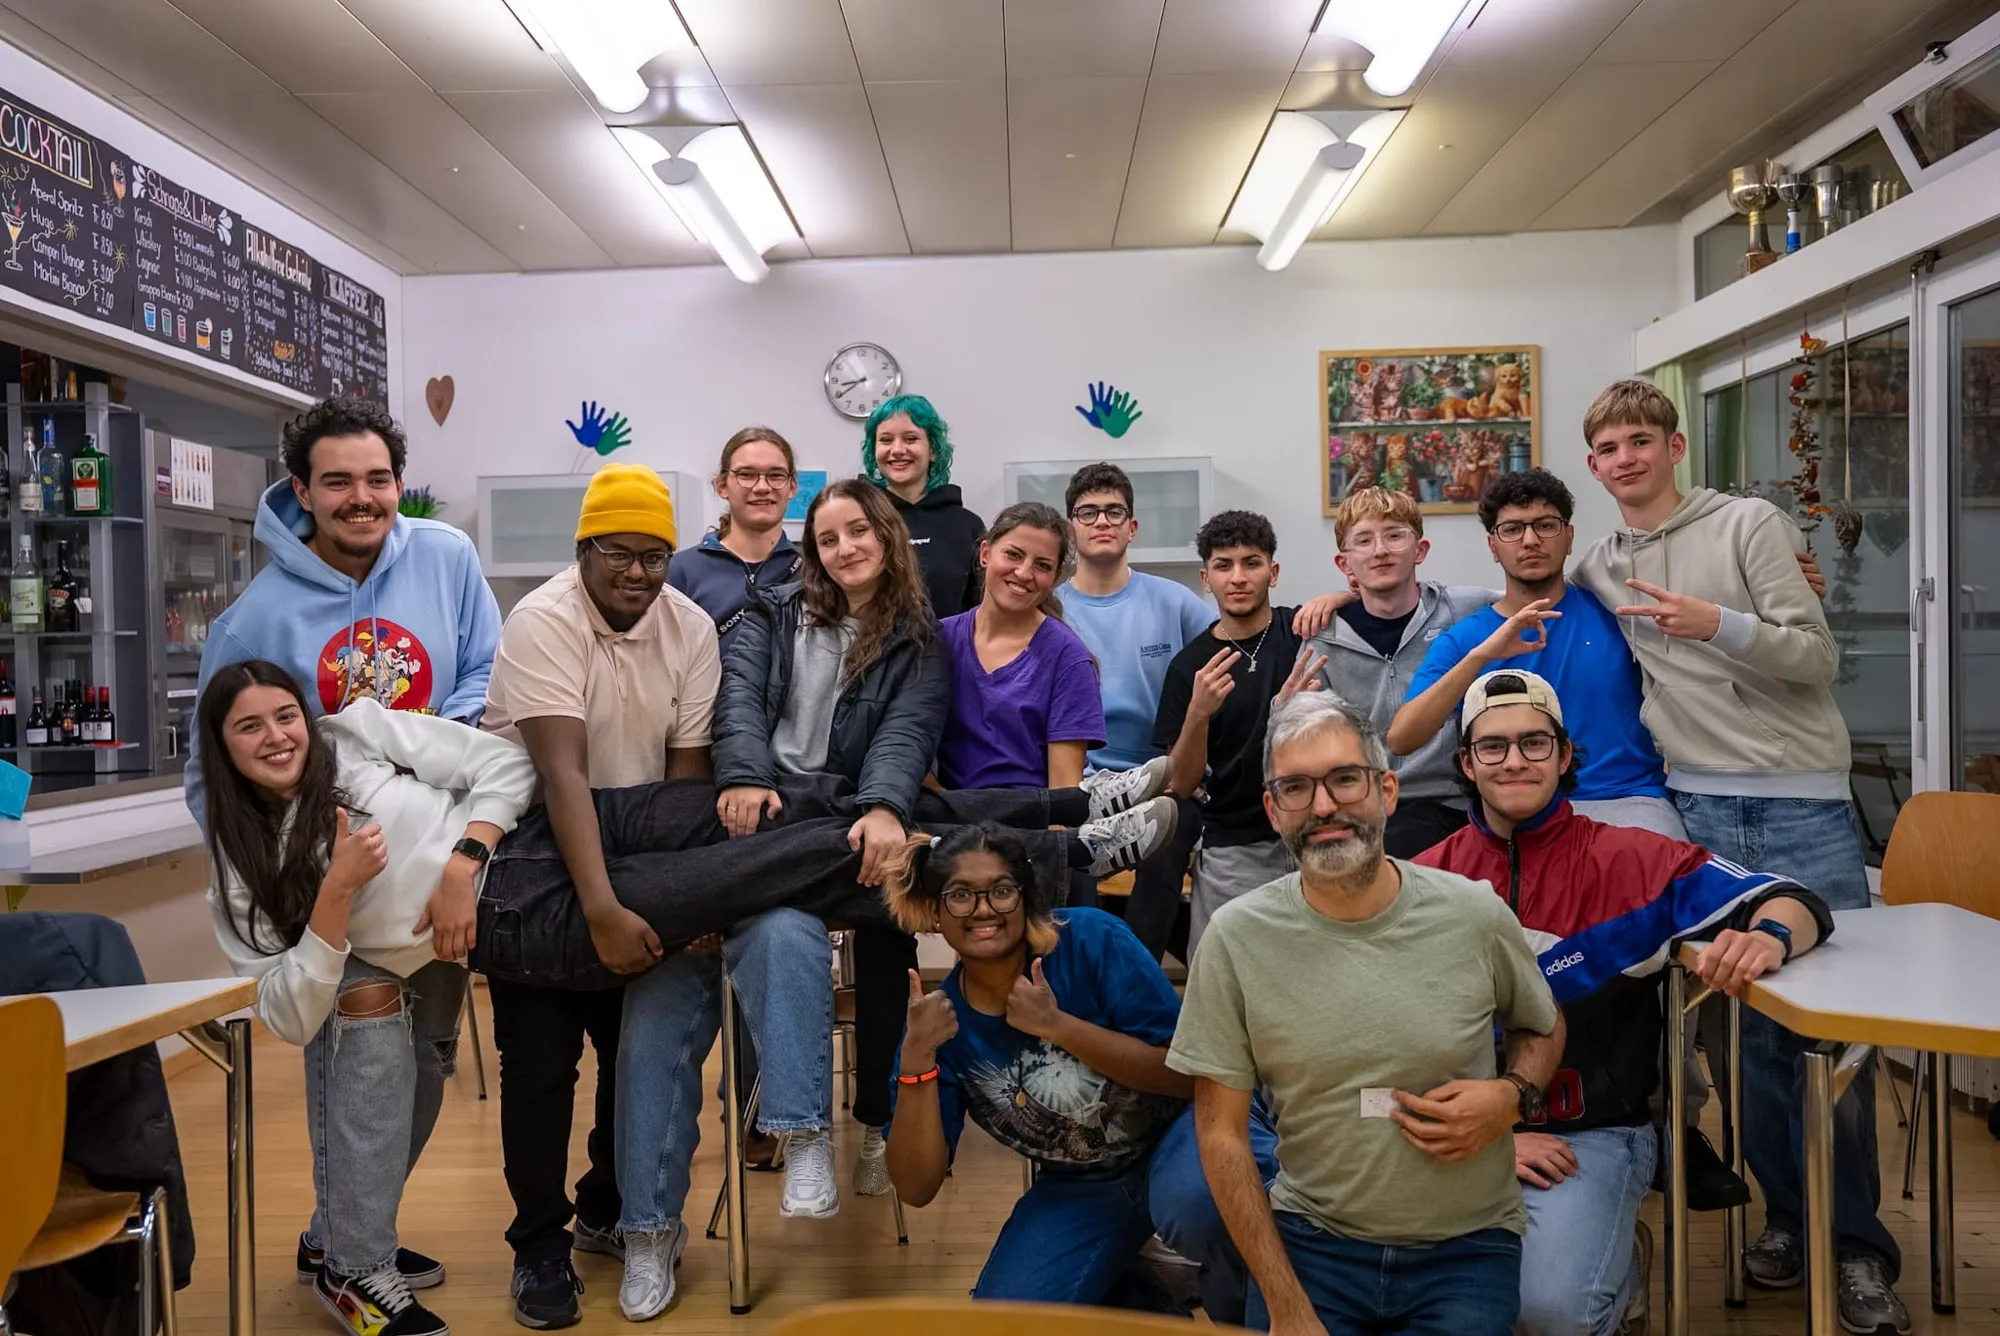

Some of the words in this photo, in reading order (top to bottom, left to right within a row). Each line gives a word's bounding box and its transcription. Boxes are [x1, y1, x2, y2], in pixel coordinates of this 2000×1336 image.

[0, 104, 90, 184] COCKTAIL
[30, 178, 56, 204] Aperol
[58, 190, 84, 217] Spritz
[31, 207, 54, 238] Hugo
[32, 233, 60, 263] Campari
[61, 244, 85, 277] Orange
[137, 249, 160, 279] Cognac
[33, 260, 60, 285] Martini
[881, 362, 889, 370] 2
[830, 377, 839, 385] 9
[845, 400, 852, 409] 7
[858, 404, 866, 412] 6
[719, 608, 746, 634] SONY
[1545, 951, 1585, 976] adidas
